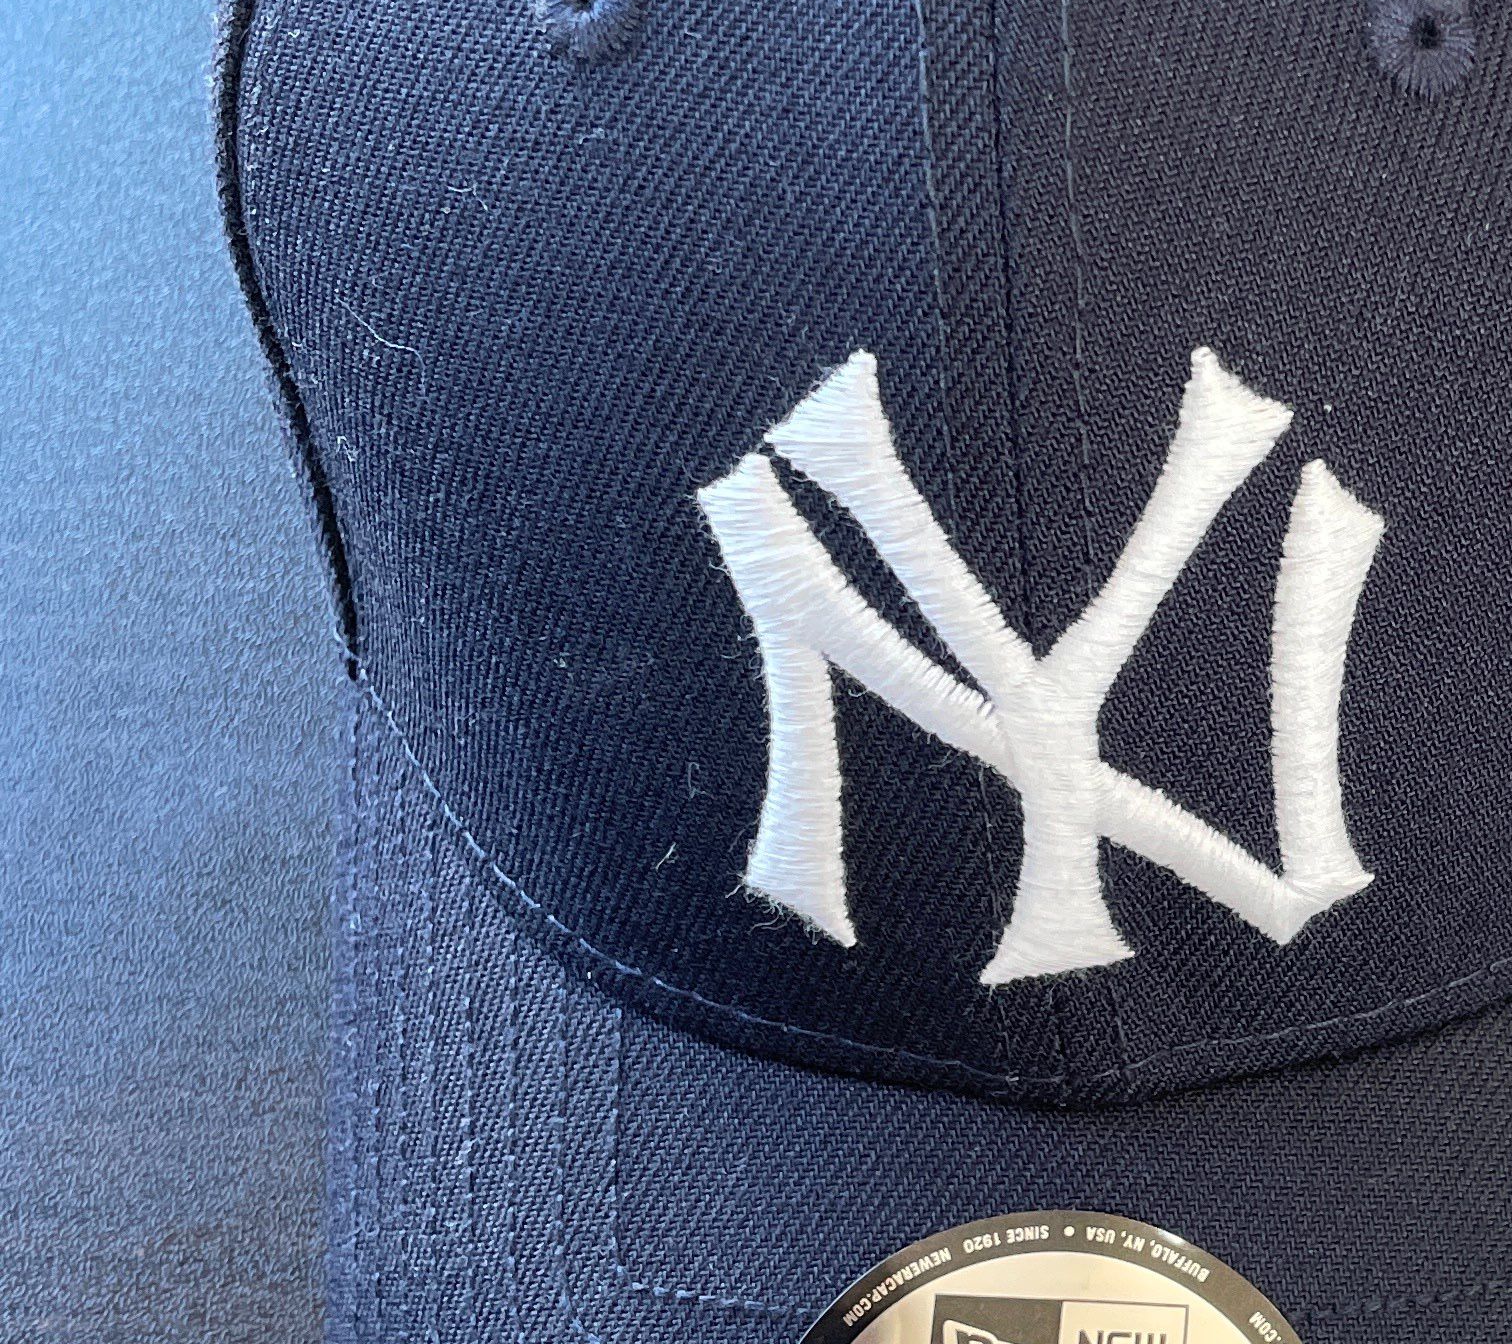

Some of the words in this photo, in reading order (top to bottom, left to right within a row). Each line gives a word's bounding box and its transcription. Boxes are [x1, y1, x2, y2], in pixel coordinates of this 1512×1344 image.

[694, 346, 1385, 986] NY
[962, 1236, 1002, 1254] 1920
[1006, 1225, 1050, 1244] SINCE
[1085, 1226, 1116, 1244] USA
[1121, 1230, 1145, 1252] NY,
[1149, 1239, 1211, 1283] BUFFALO,
[842, 1247, 952, 1327] NEWERACAP.COM
